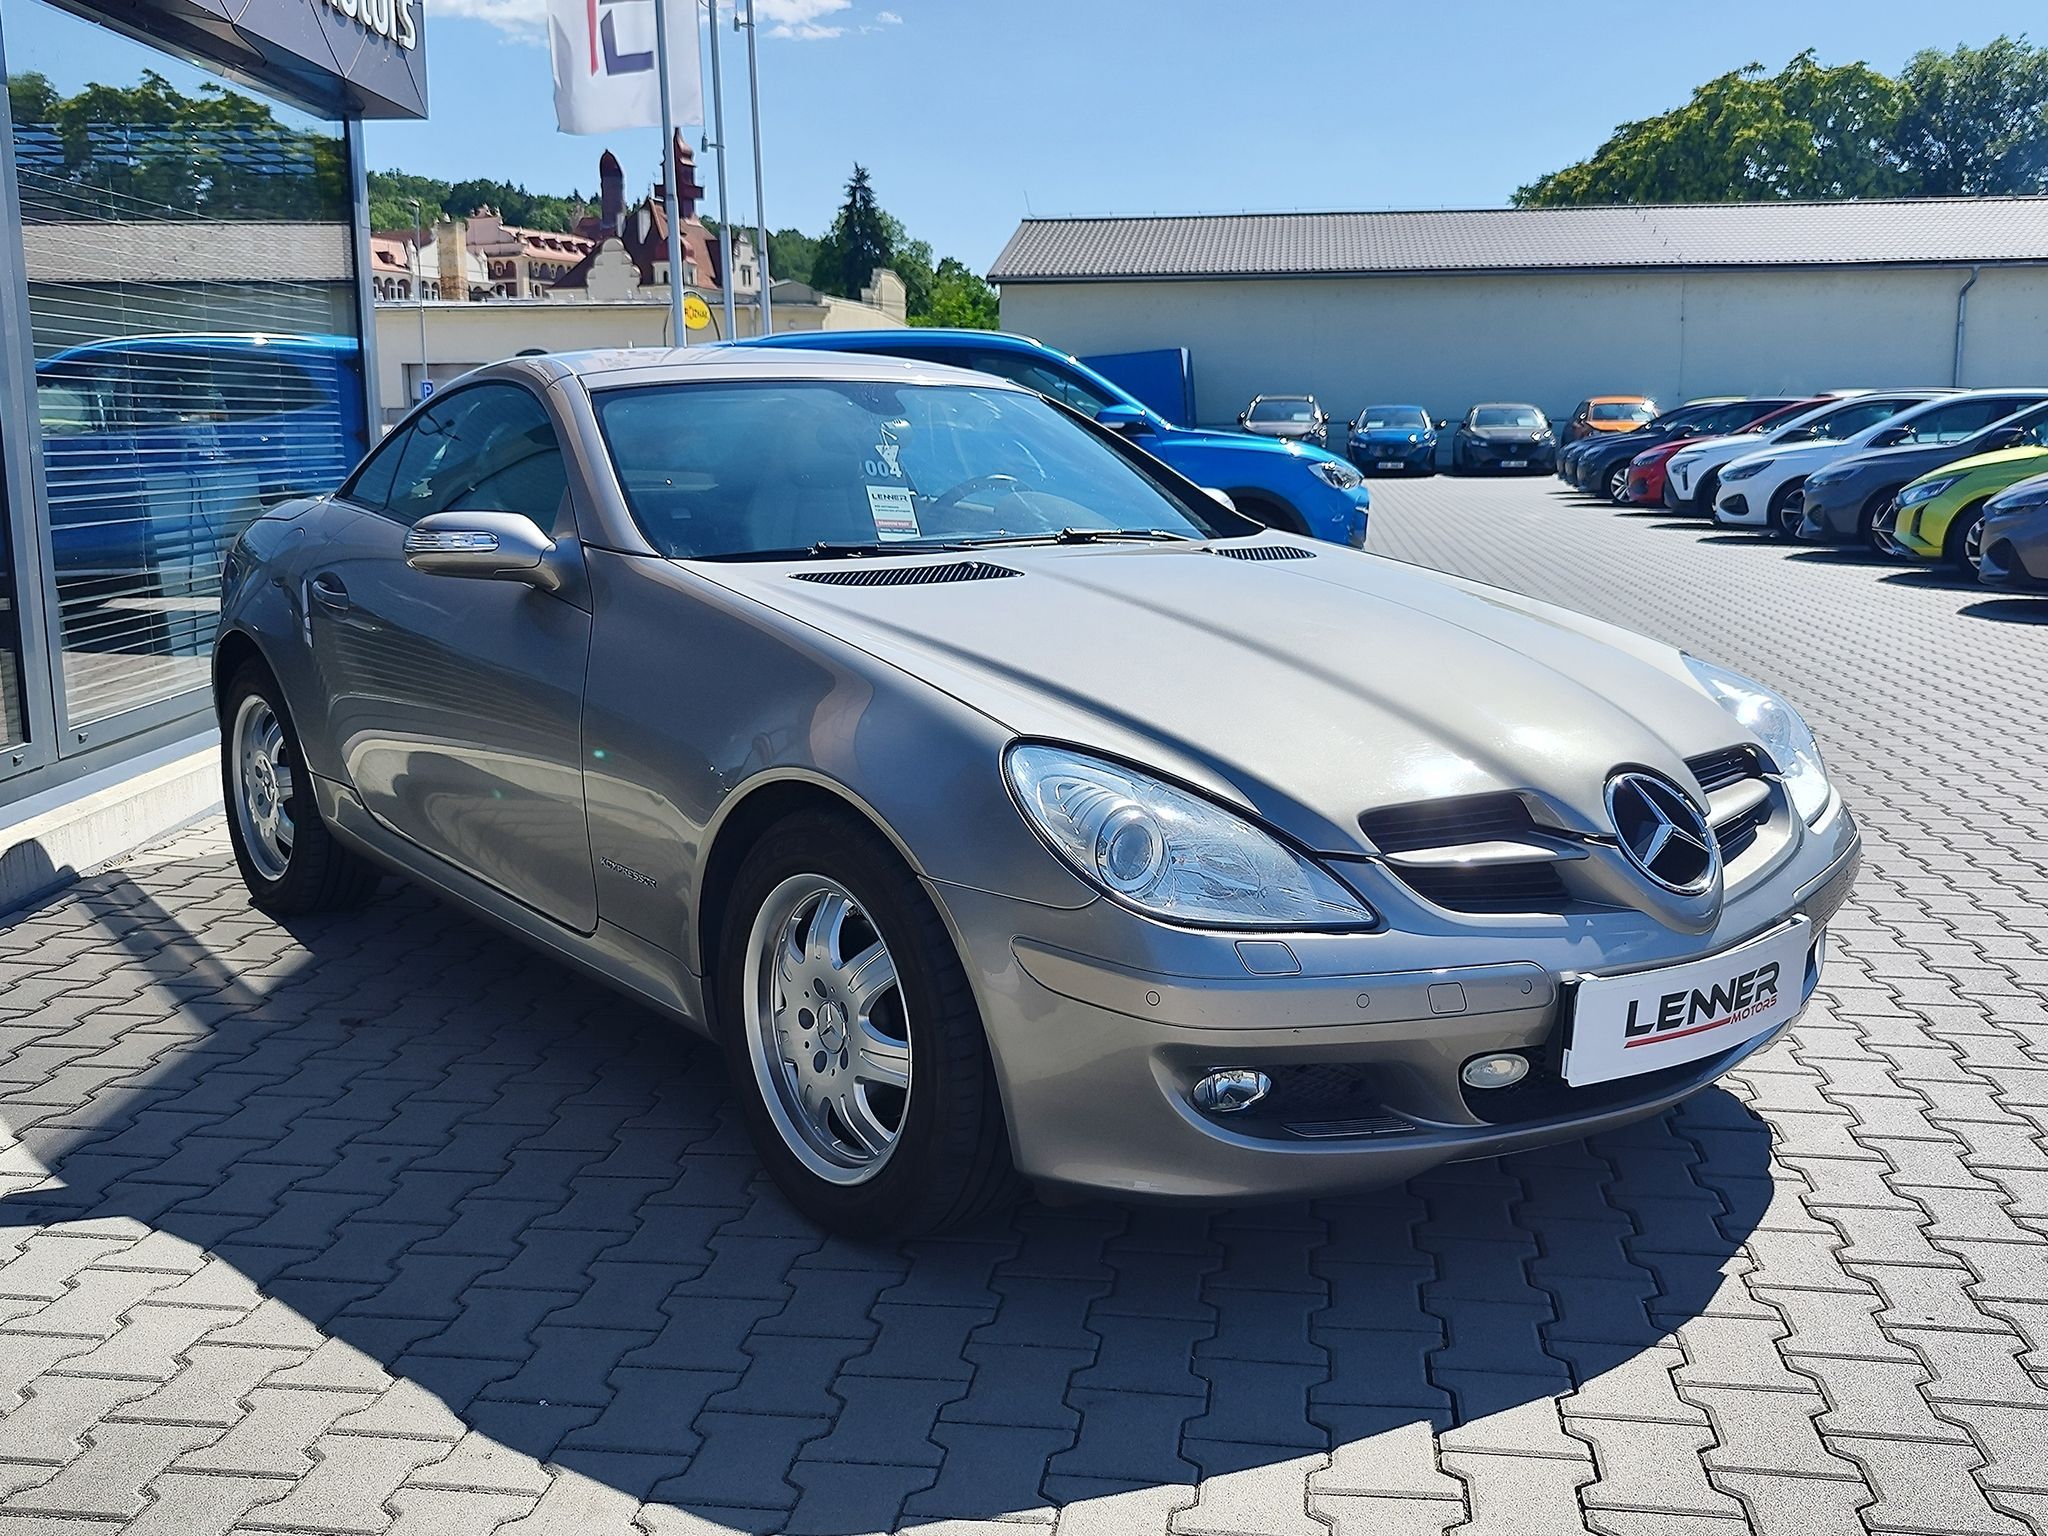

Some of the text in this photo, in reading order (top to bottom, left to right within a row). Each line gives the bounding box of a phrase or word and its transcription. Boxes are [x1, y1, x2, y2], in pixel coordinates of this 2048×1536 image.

[871, 493, 908, 502] LENNER
[1625, 961, 1780, 1037] LENNER
[1730, 994, 1777, 1025] MOTORS
